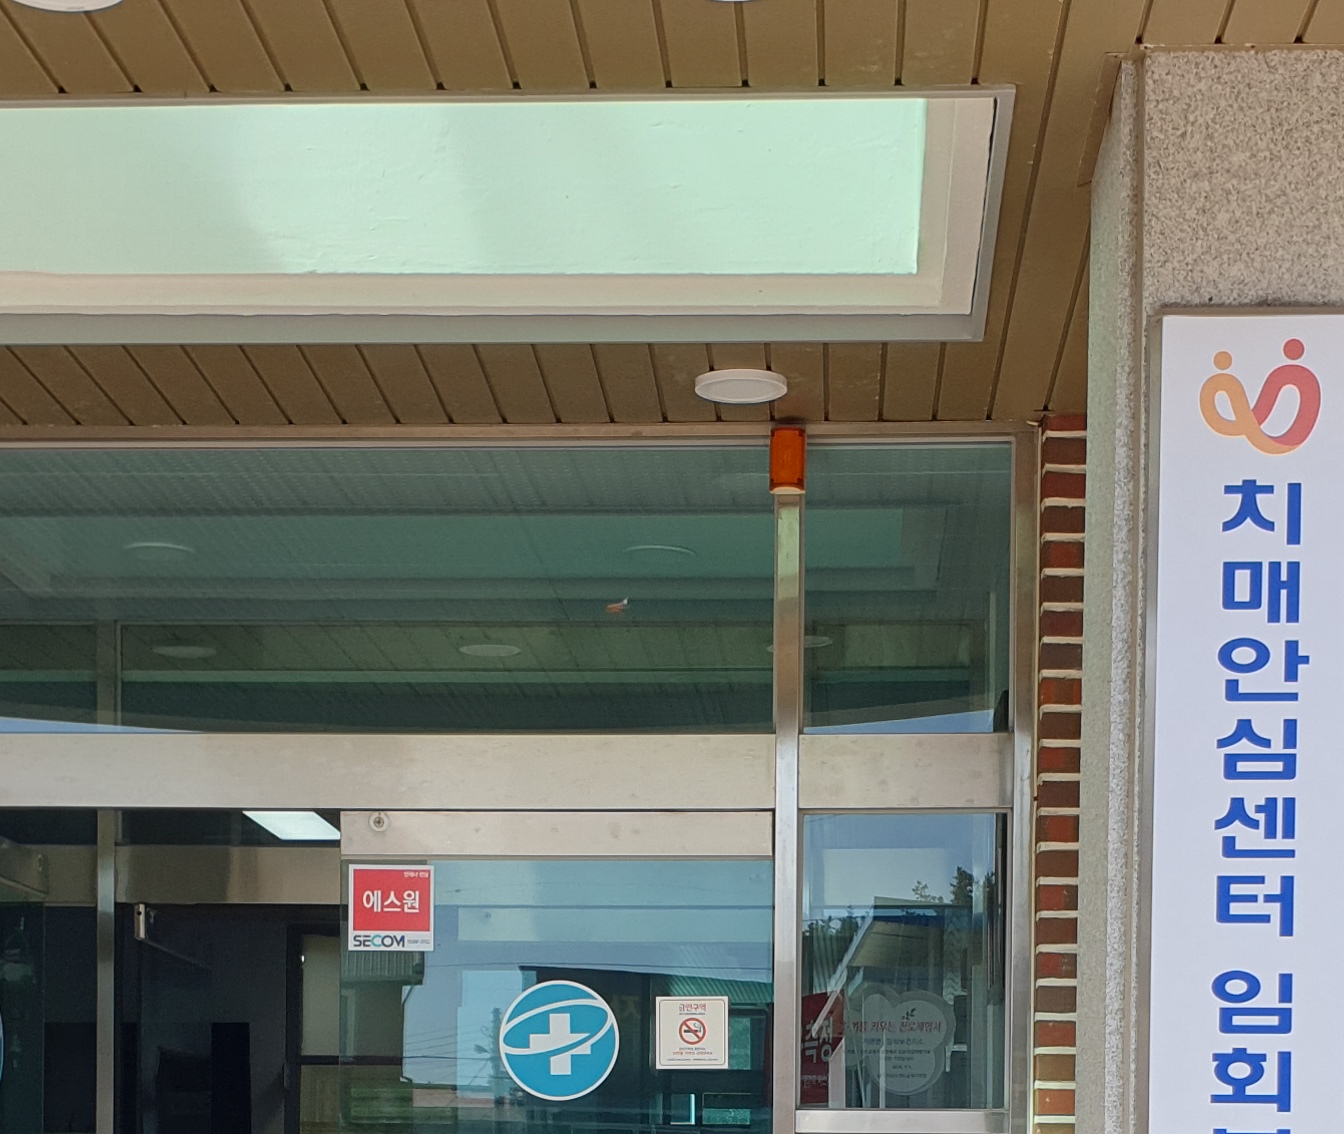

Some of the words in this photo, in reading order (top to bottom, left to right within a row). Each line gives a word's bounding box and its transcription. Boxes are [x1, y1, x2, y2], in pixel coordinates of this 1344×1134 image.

[1213, 478, 1310, 938] 치매안심센터
[362, 890, 420, 913] 에스원
[353, 934, 405, 948] SECOM
